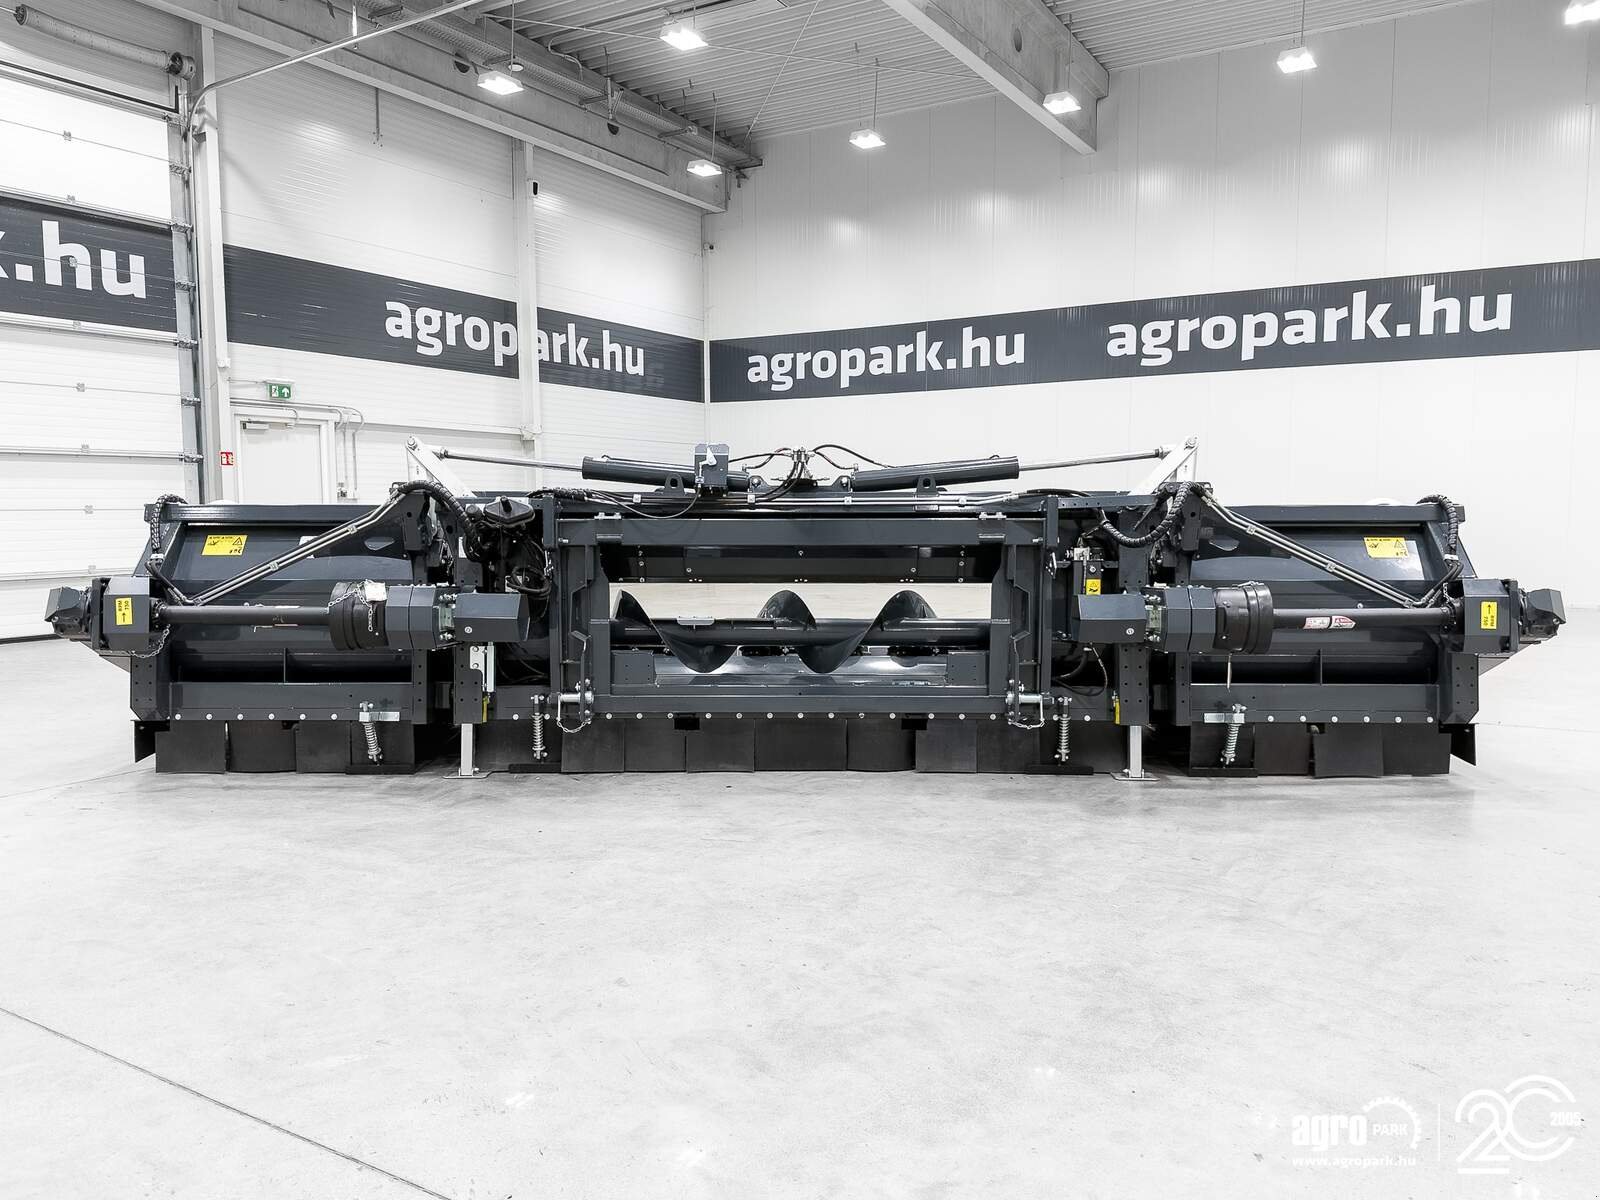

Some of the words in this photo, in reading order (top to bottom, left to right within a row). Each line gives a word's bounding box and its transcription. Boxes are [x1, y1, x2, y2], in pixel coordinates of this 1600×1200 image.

[0, 220, 146, 298] .hu
[747, 326, 1025, 391] agropark.hu
[1107, 285, 1513, 366] agropark.hu
